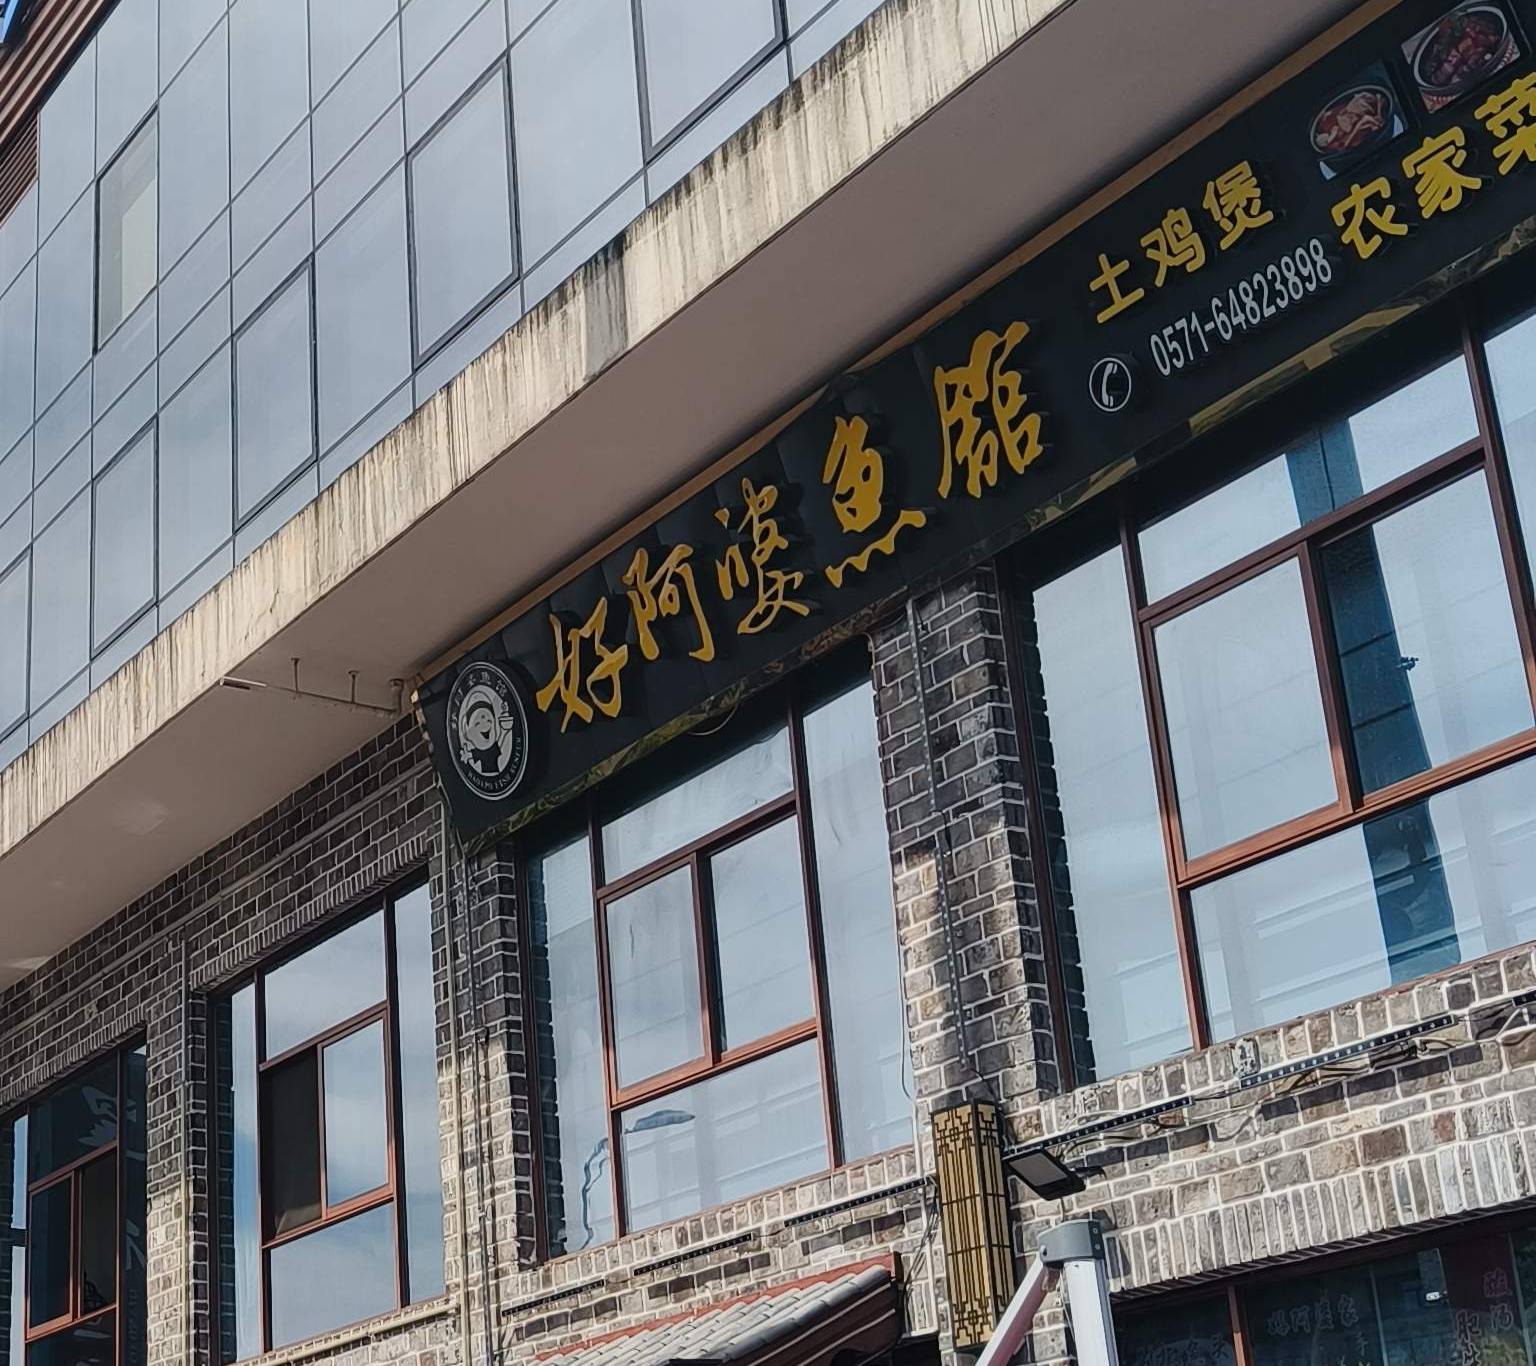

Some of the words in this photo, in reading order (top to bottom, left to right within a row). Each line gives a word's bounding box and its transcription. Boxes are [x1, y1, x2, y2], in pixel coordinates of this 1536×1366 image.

[1089, 160, 1274, 324] 土鸡煲
[1330, 72, 1536, 259] 农家菜
[1150, 238, 1332, 376] 0571-64823898
